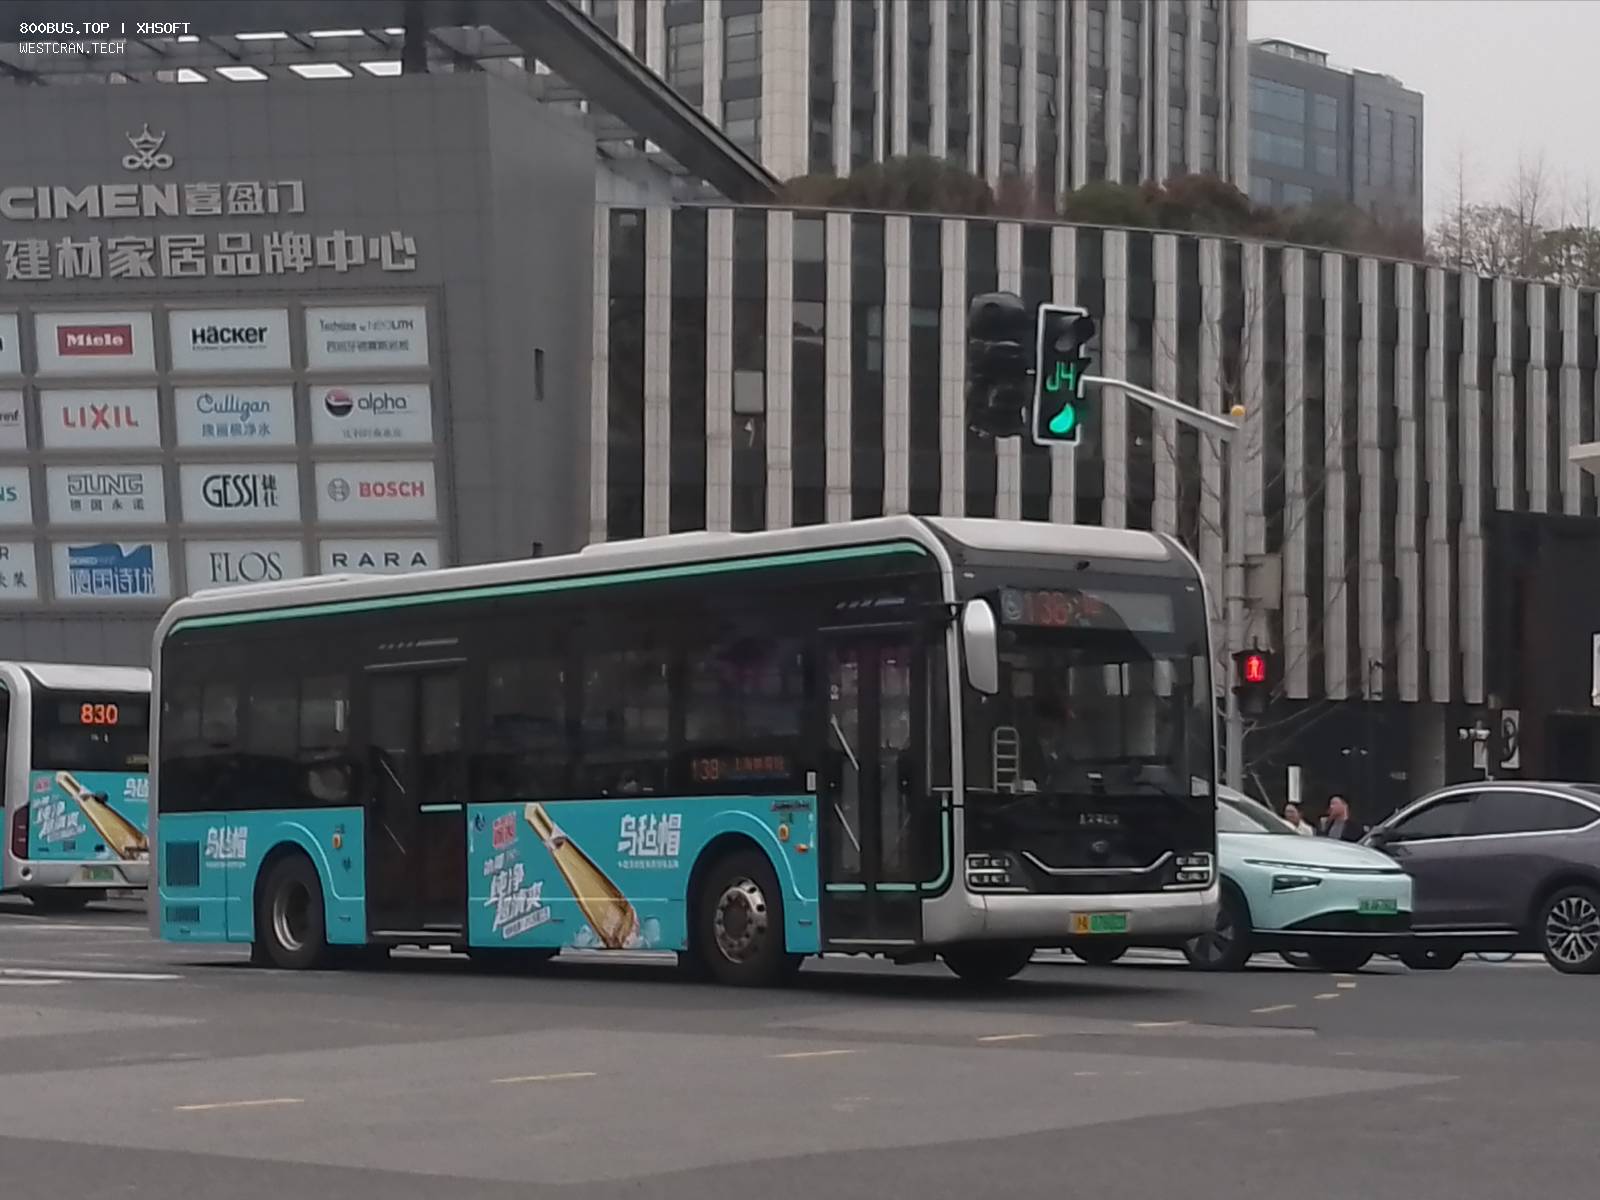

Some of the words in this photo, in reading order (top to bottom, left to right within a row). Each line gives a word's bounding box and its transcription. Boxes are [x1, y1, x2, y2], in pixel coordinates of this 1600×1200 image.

[0, 184, 180, 219] CIMEN
[184, 181, 305, 217] 喜盈门
[2, 230, 418, 281] 建材家居品牌中心
[66, 333, 124, 348] Miele
[196, 392, 270, 422] Culligan
[358, 392, 407, 415] alpha
[62, 404, 139, 430] LIXIL
[68, 473, 143, 495] JUNG
[202, 474, 258, 507] GESSI
[359, 481, 425, 498] BOSCH
[209, 552, 283, 583] FLOS
[332, 552, 427, 568] RARA
[80, 703, 118, 724] 830
